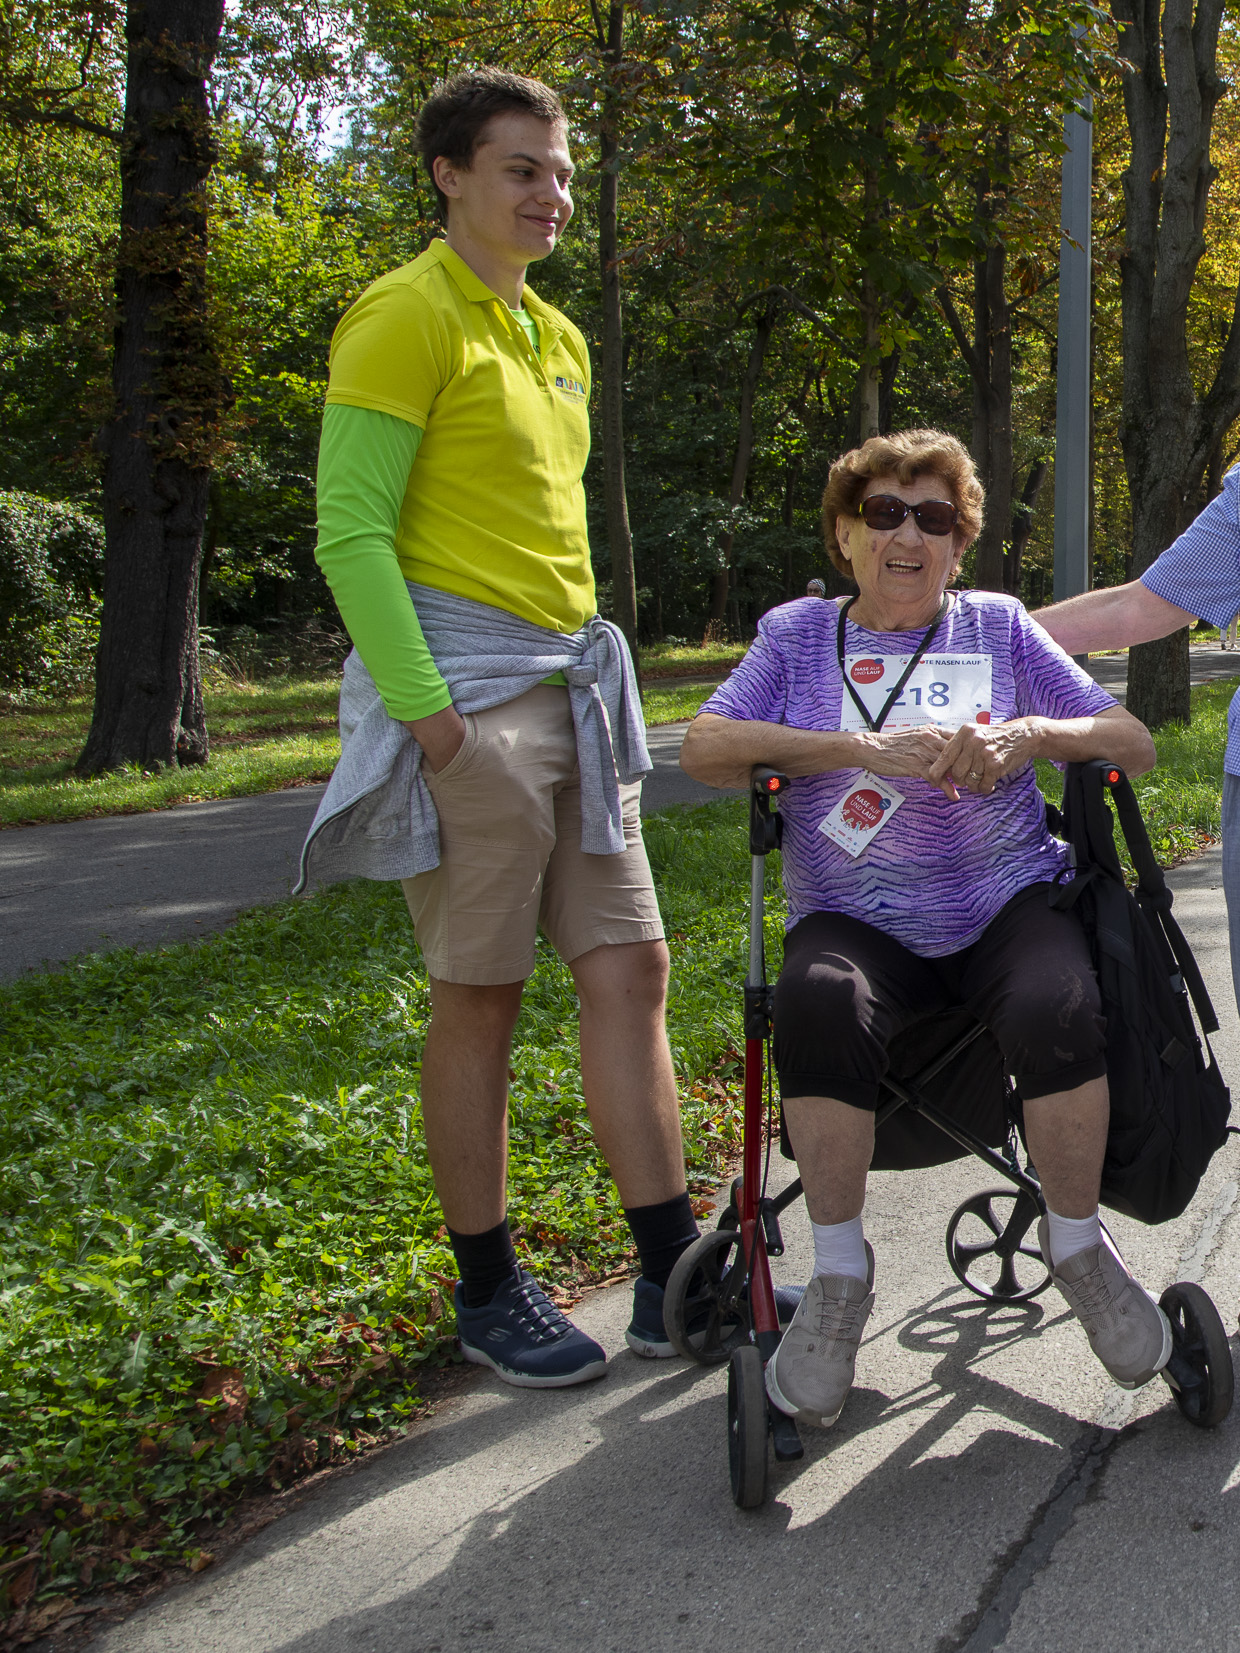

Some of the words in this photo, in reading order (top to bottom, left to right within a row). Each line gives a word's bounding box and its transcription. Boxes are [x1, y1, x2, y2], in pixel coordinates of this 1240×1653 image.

[849, 799, 863, 812] UND
[861, 808, 877, 821] LAUF
[854, 794, 870, 809] NASE
[868, 804, 881, 815] AUF
